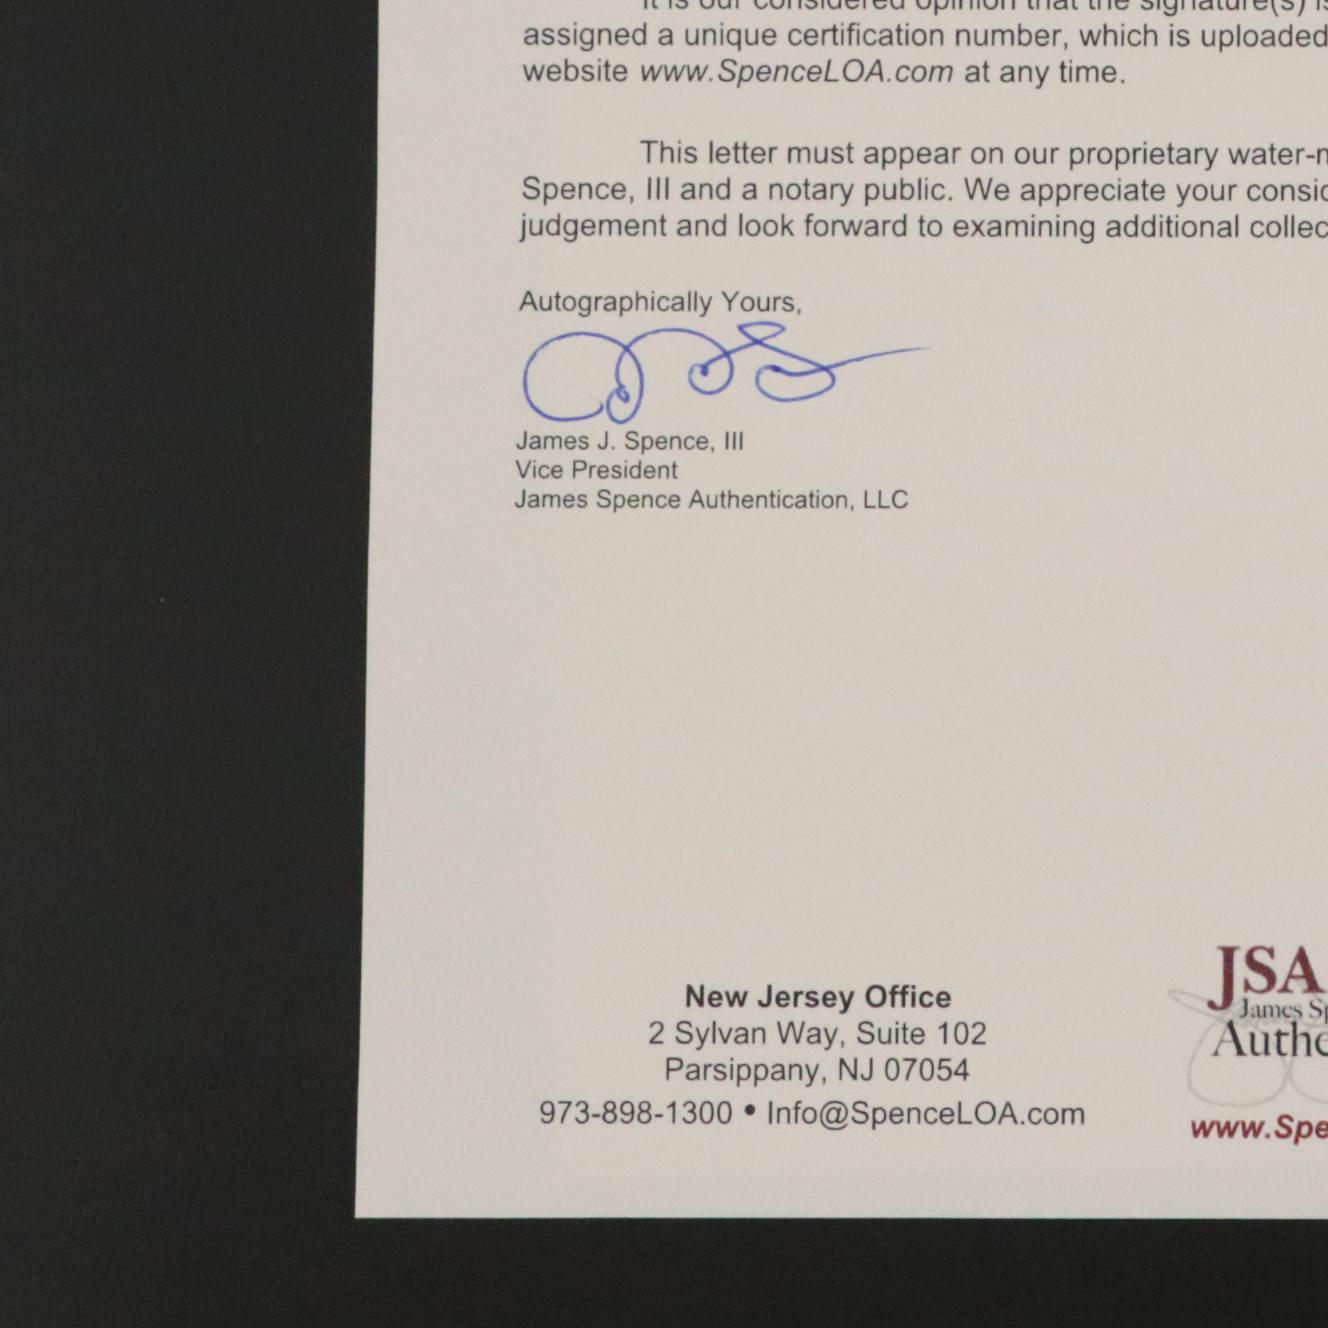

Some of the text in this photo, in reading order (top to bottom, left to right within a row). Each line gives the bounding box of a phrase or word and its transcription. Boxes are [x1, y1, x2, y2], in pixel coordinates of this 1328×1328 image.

[523, 58, 1125, 89] website www.SpenceLOA.com at any time.
[519, 290, 801, 318] Autographically Yours,
[516, 430, 743, 455] James J. Spence, III
[515, 460, 678, 479] Vice President
[514, 489, 908, 513] James Spence Authentication, LLC
[1207, 945, 1326, 1011] JSA
[686, 984, 952, 1015] New Jersey Office
[1239, 1000, 1303, 1019] James
[649, 1020, 986, 1051] 2 Sylvan Way, Suite 102
[666, 1057, 970, 1088] Parsippany, NJ 07054
[540, 1100, 1085, 1131] 973-898-1300 Info@SpenceLOA.com
